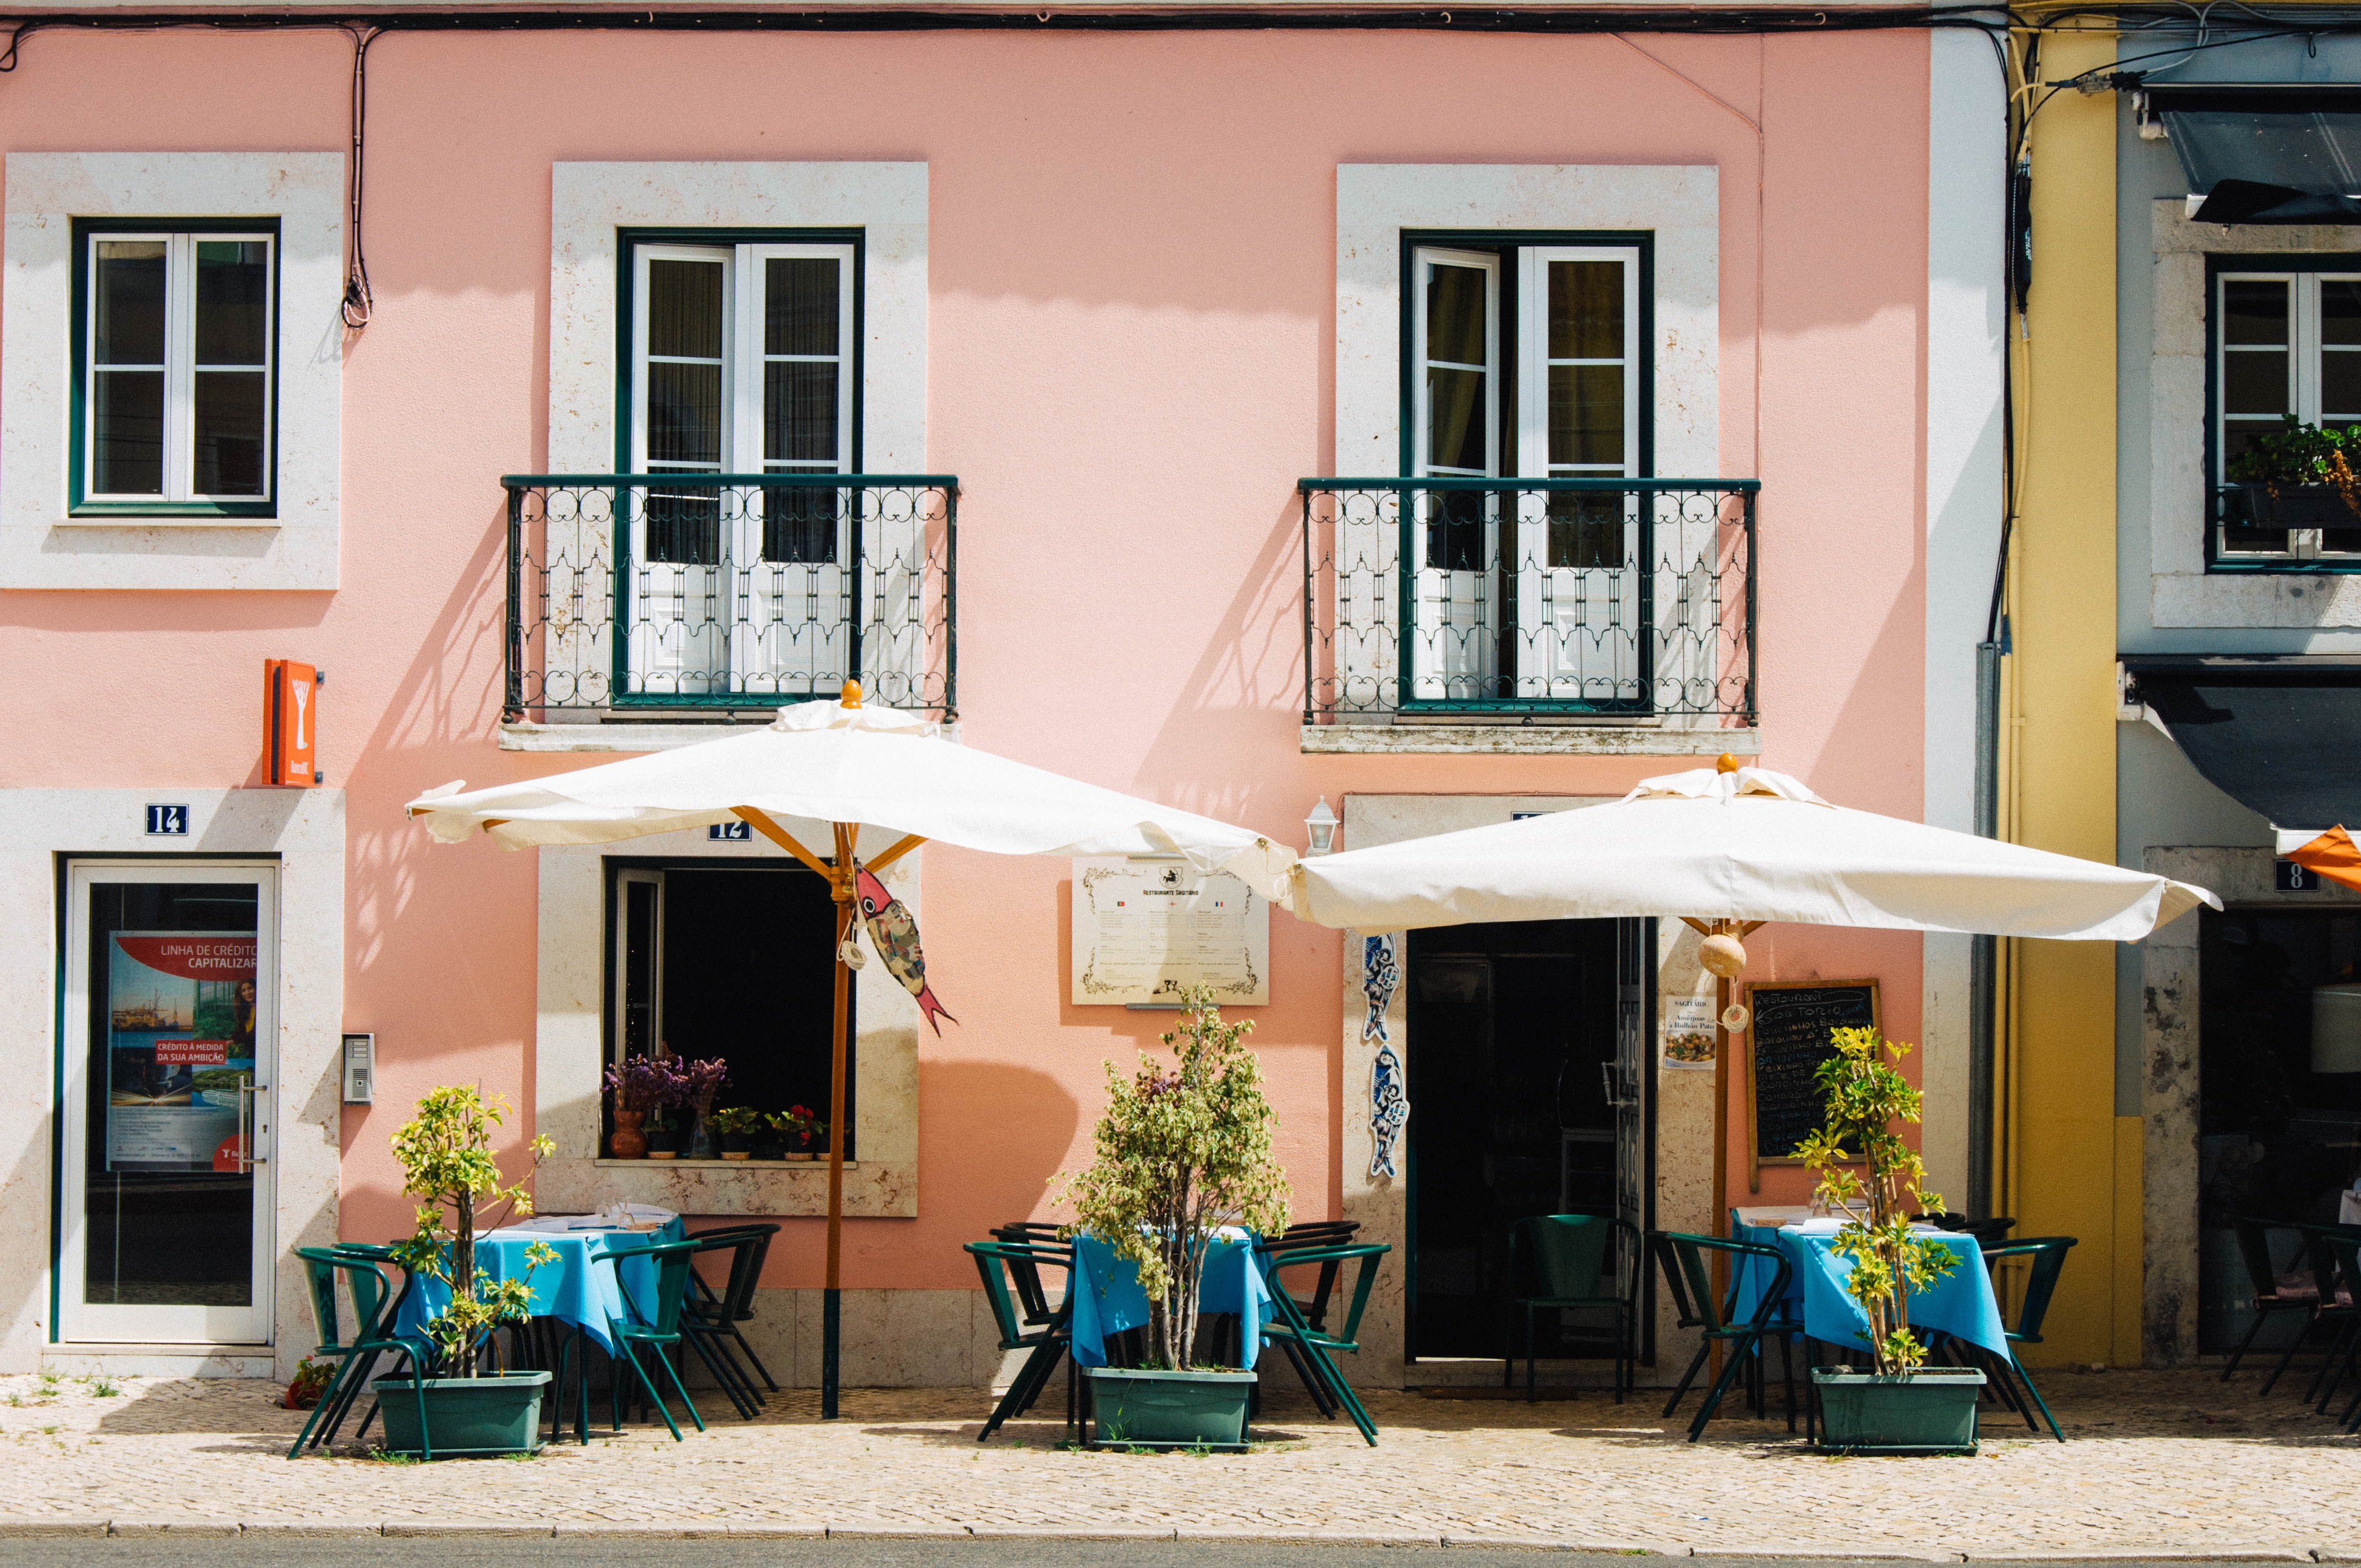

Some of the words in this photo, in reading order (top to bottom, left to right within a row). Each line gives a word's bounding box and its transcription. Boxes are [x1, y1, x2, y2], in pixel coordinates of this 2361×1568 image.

[155, 807, 180, 832] 14
[718, 821, 741, 838] 12
[2291, 863, 2302, 888] 8
[161, 946, 193, 955] LINHA
[197, 946, 210, 955] DE
[158, 1042, 188, 1050] CRÉDITO
[188, 1052, 224, 1063] AMBIÇÃO
